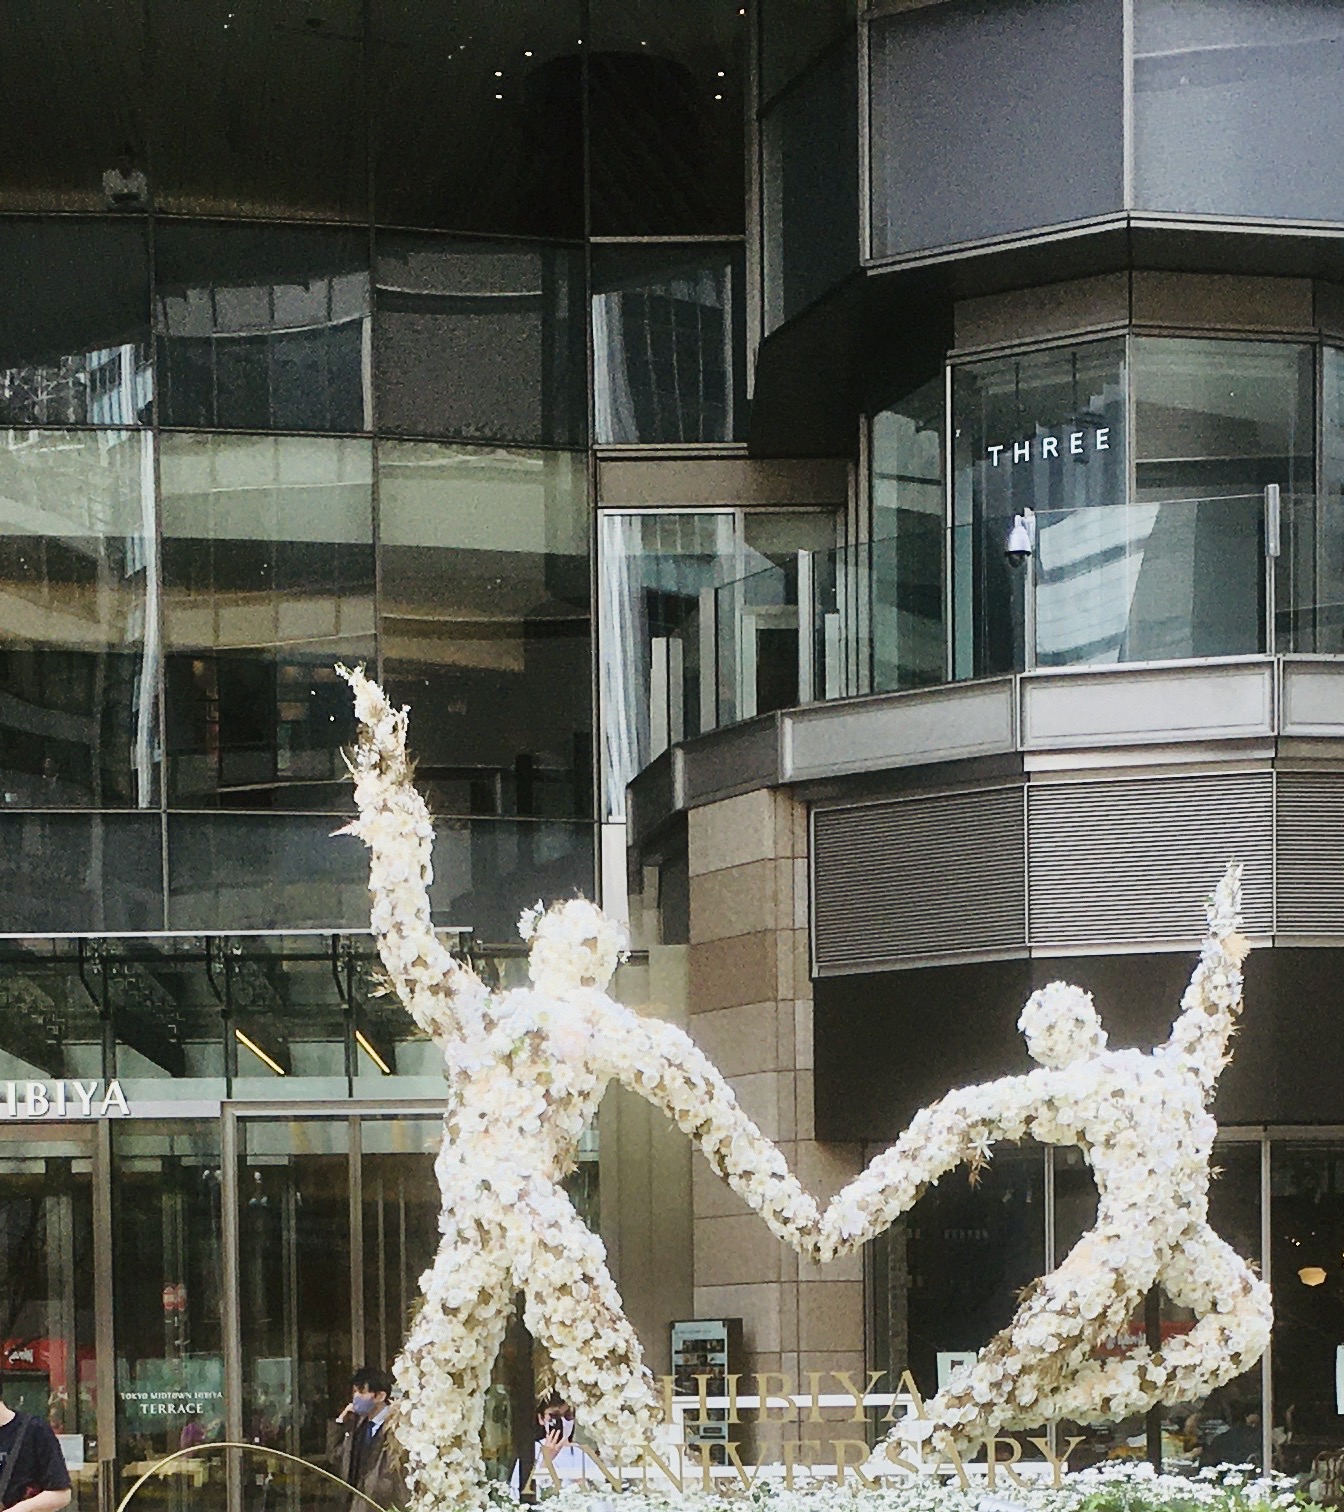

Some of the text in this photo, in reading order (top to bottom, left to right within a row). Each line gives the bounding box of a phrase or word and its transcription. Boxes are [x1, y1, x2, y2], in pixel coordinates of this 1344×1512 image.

[987, 427, 1111, 467] THREE
[140, 1403, 204, 1414] TERRACE
[656, 1370, 930, 1425] HIBIYA
[520, 1436, 1087, 1495] ANNIVERSARY
